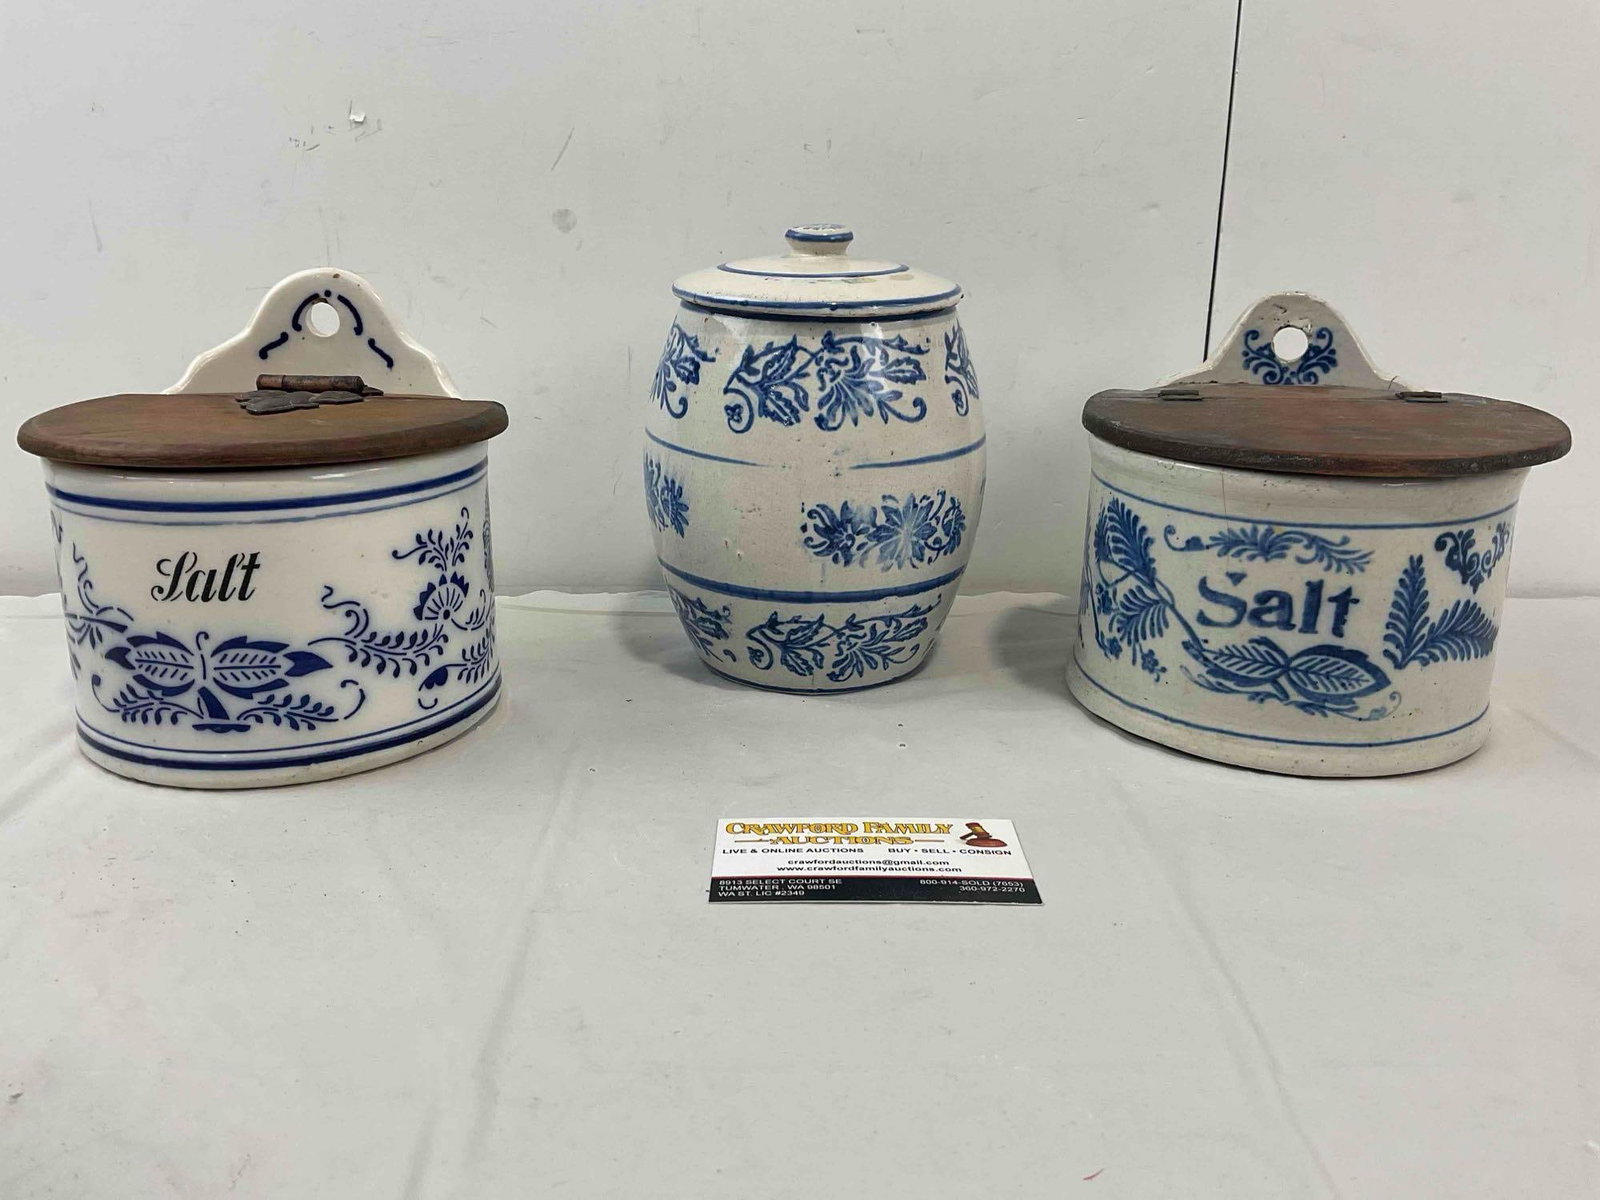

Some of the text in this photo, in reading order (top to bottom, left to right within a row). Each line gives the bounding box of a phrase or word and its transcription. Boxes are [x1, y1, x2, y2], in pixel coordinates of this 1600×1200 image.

[150, 551, 261, 602] Salt
[1196, 571, 1360, 638] Salt
[726, 821, 953, 836] CRAWFORD FAMILY
[771, 836, 914, 845] AUCTIONS
